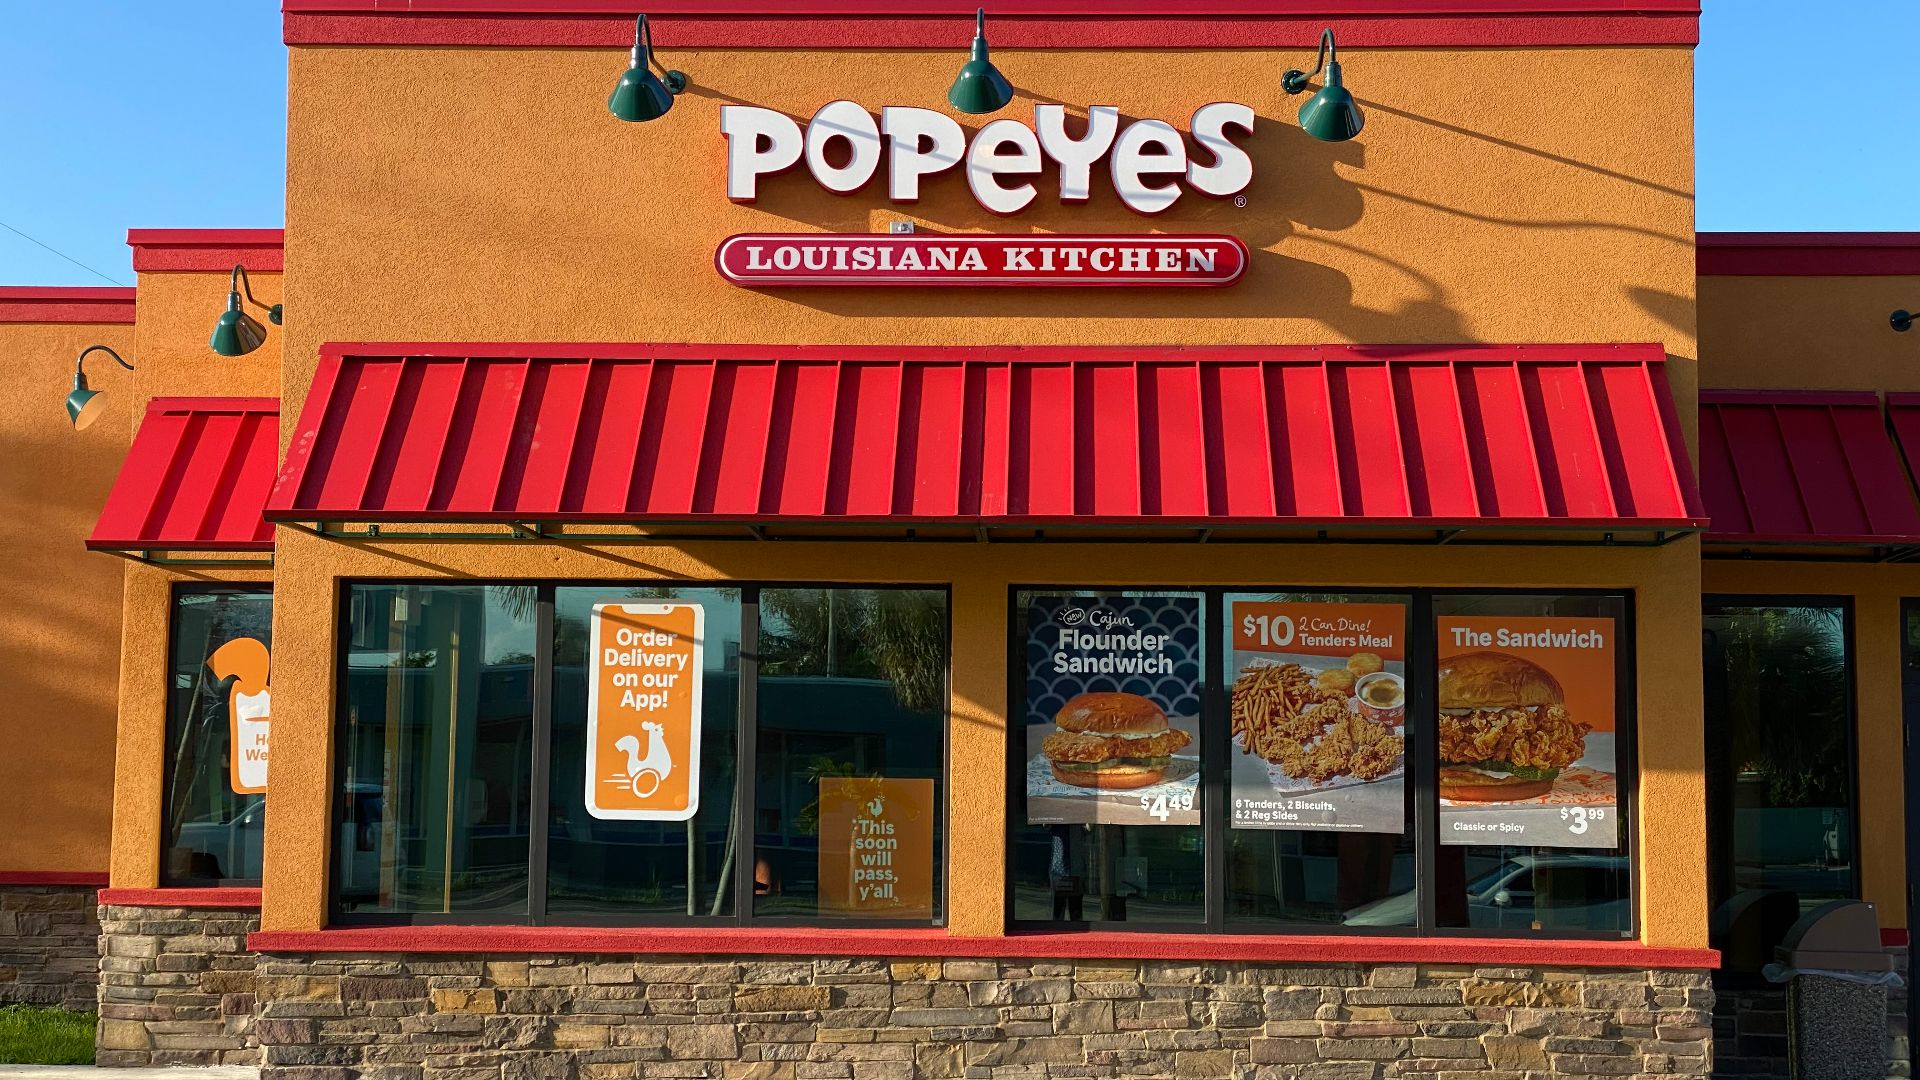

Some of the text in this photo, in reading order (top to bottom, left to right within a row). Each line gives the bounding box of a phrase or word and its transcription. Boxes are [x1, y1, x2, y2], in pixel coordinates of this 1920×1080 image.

[746, 246, 1218, 272] LOUISIANA KITCHEN
[1090, 611, 1135, 630] Cajun
[1299, 616, 1371, 633] 2 Can Dine!
[616, 628, 678, 647] Order
[1243, 614, 1295, 646] $10
[1451, 628, 1603, 649] The Sandwich
[1059, 629, 1170, 650] Flounder
[1299, 633, 1393, 648] Tenders Meal
[604, 648, 688, 671] Delivery
[1053, 652, 1173, 674] Sandwich
[612, 673, 679, 687] on our
[620, 689, 668, 711] App!
[1235, 799, 1336, 812] 6 Tenders, 2 Biscuits,
[1235, 810, 1298, 822] & 2 Reg Sides
[859, 819, 895, 834] This
[1453, 822, 1525, 834] Classic or Spicy
[855, 838, 897, 849] soon
[861, 851, 892, 865] will
[854, 869, 898, 883] pass,
